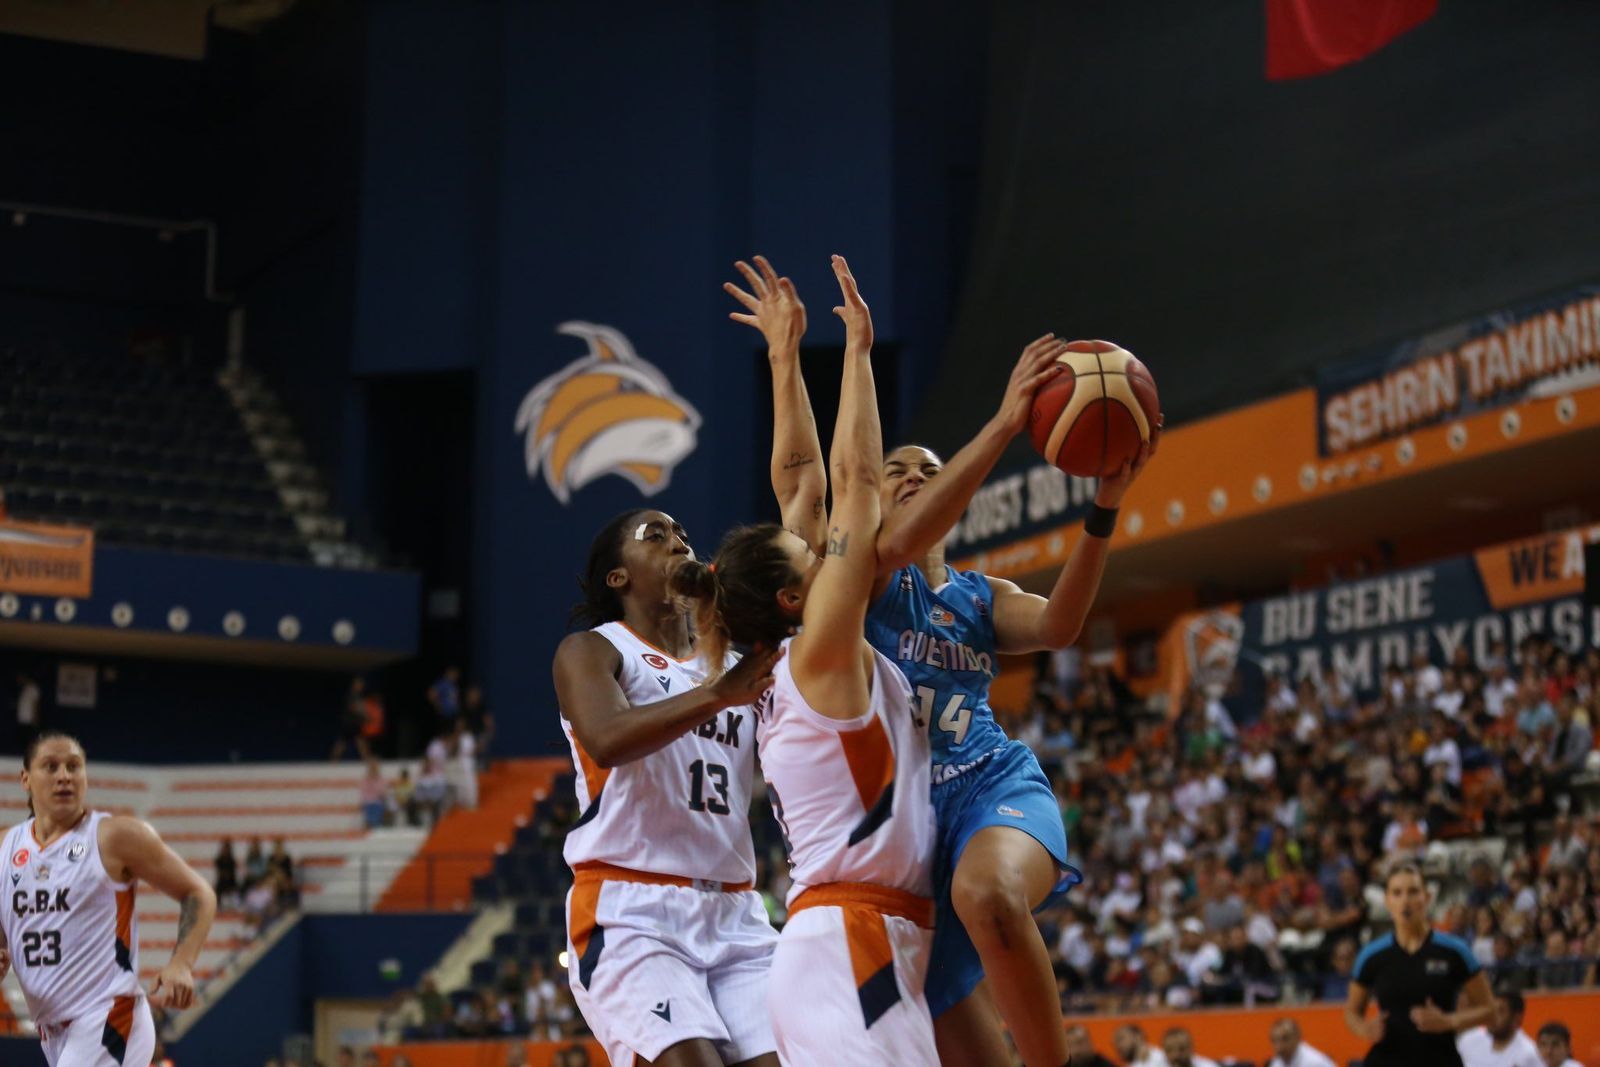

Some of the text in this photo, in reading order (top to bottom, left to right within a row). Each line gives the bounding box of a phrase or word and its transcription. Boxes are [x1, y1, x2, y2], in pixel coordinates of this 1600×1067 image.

[1325, 568, 1437, 634] SENE
[914, 684, 972, 745] 14
[688, 759, 730, 816] 13
[12, 888, 70, 918] Ç.B.K
[22, 930, 61, 967] 23
